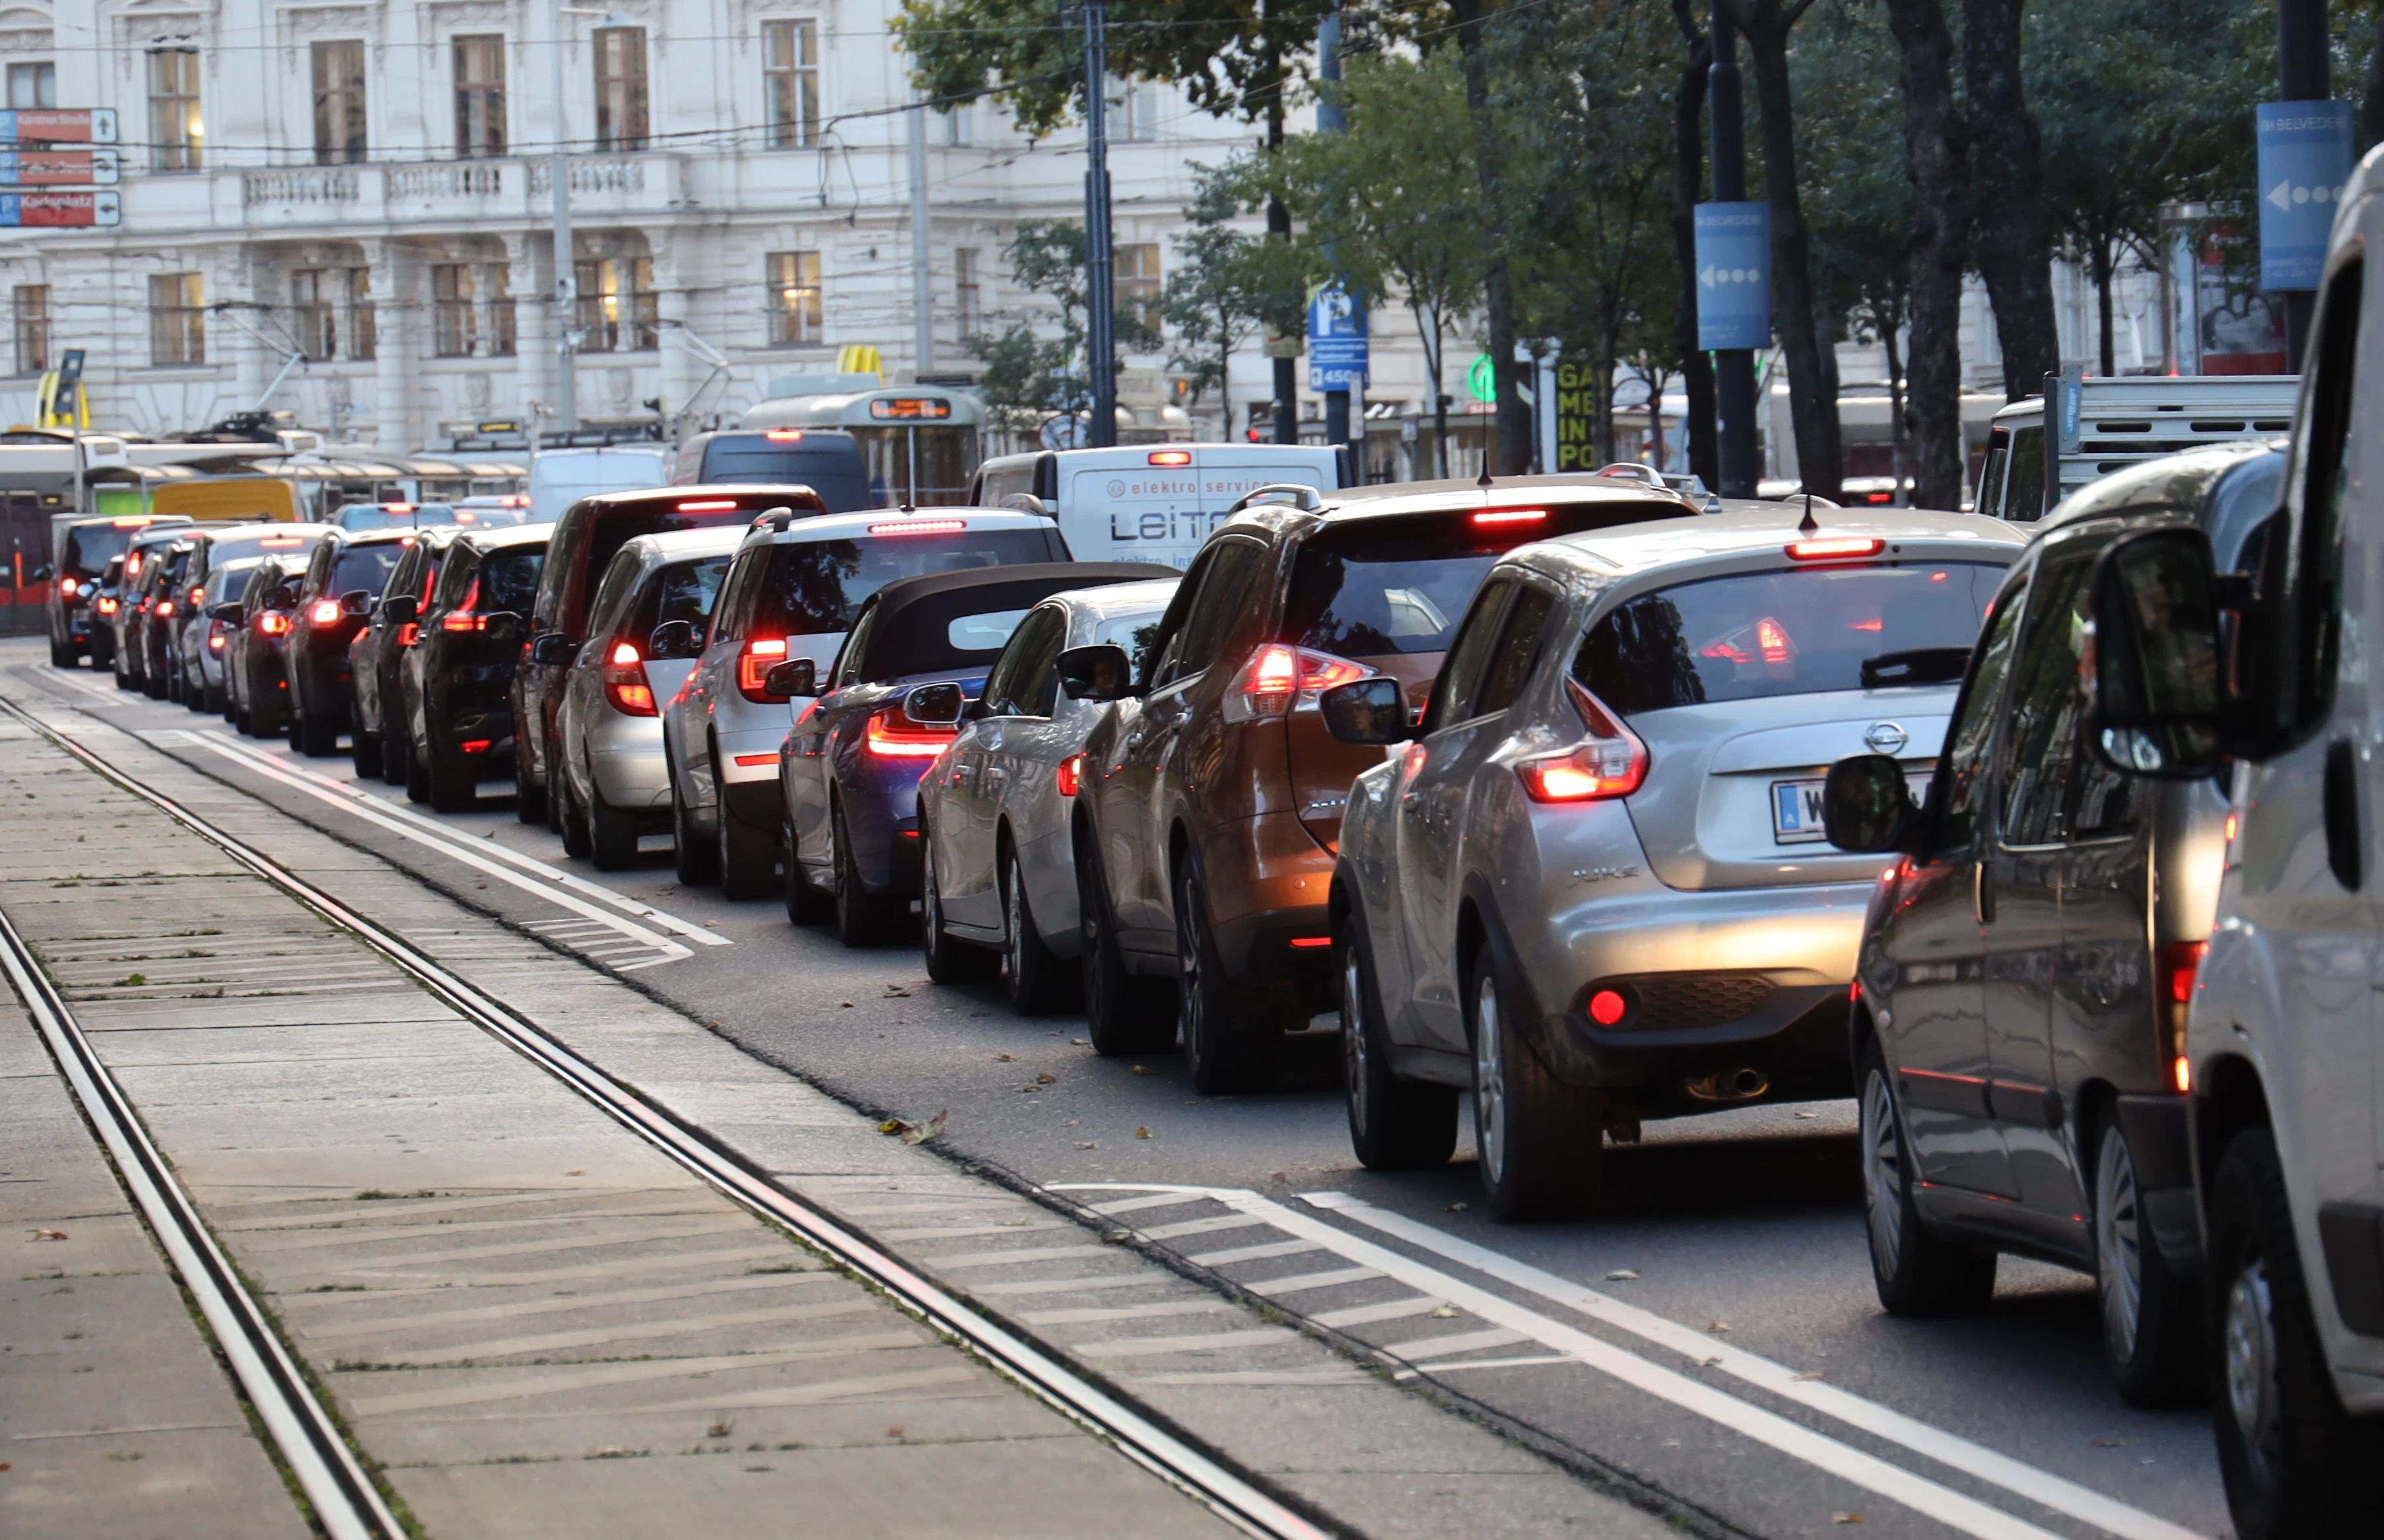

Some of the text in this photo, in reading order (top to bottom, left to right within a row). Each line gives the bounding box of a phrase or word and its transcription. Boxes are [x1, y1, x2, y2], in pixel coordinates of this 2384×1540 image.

[20, 195, 92, 211] Karlsplatz
[1559, 418, 1586, 442] IN
[1132, 481, 1196, 494] elektro
[1173, 553, 1192, 568] ins
[1786, 813, 1795, 823] A
